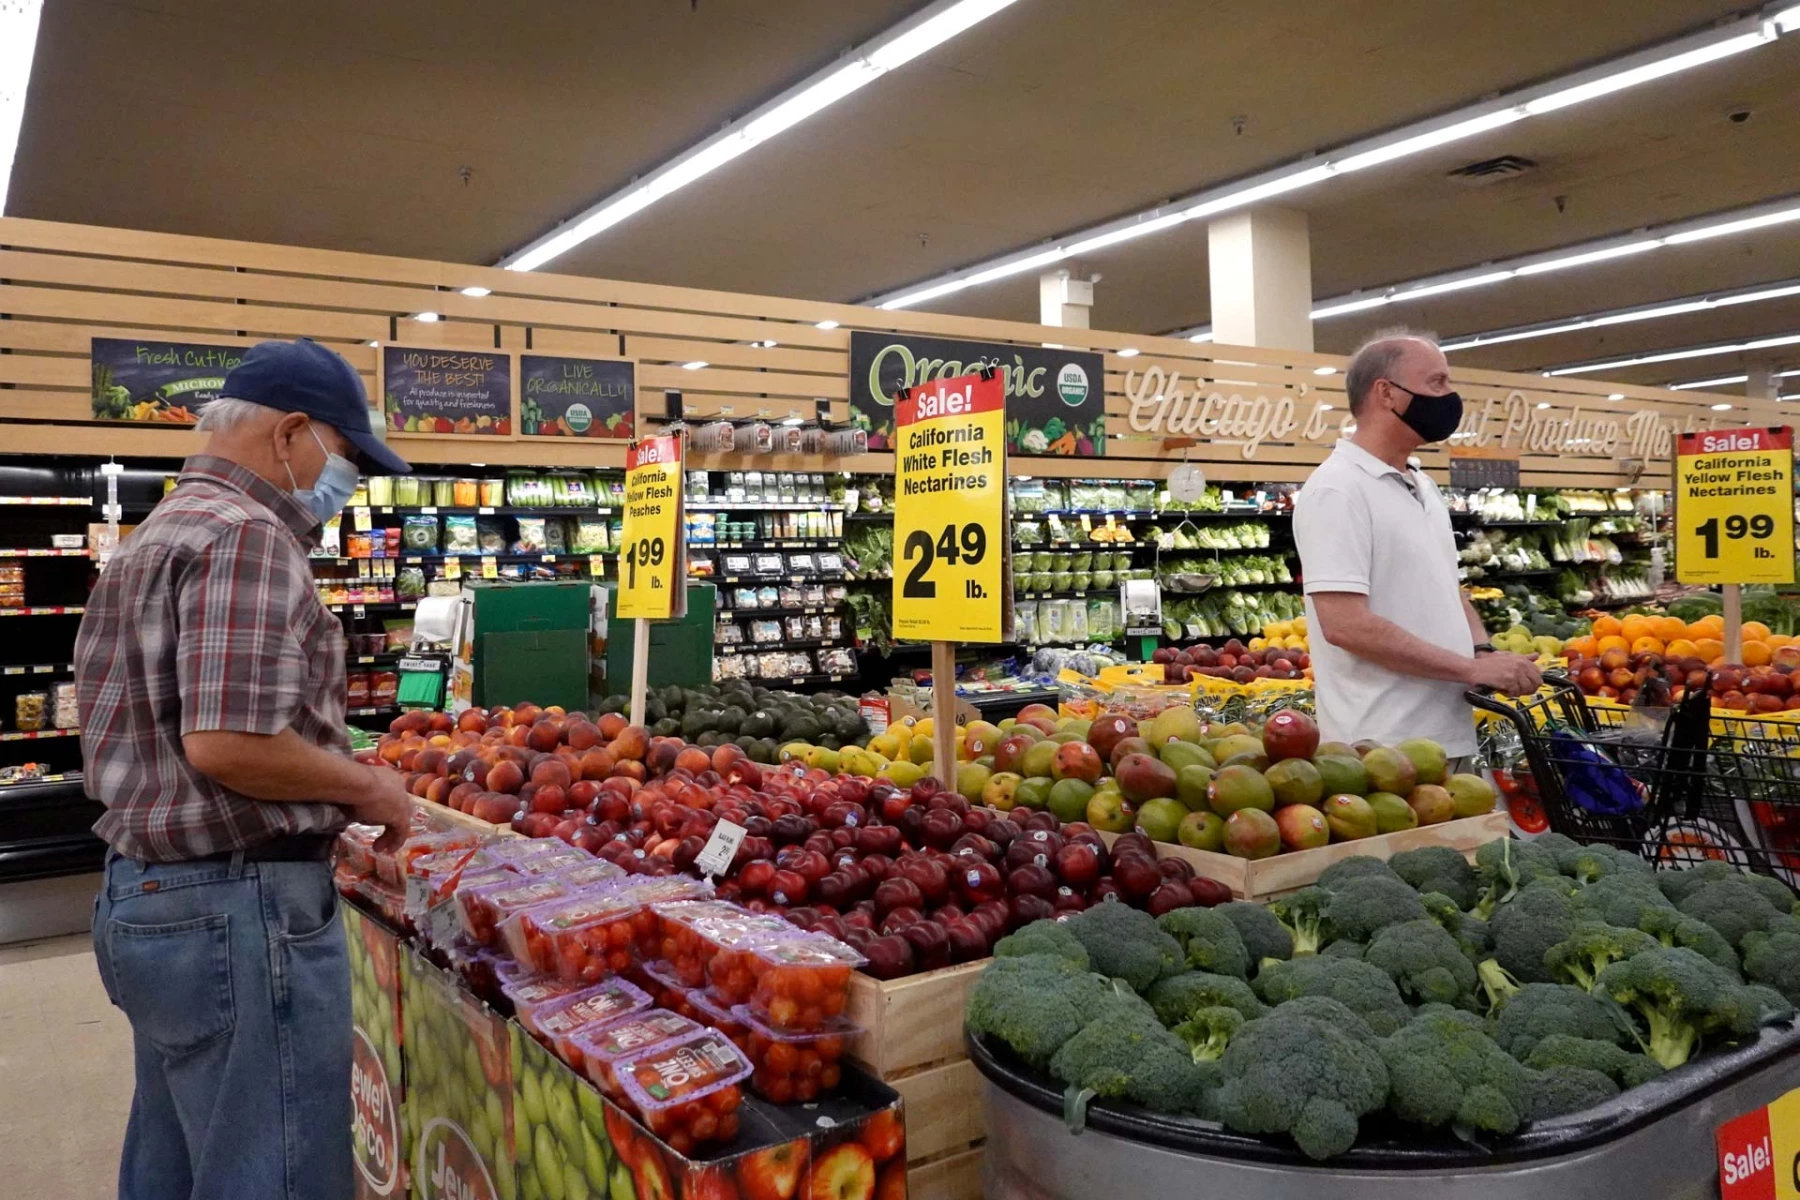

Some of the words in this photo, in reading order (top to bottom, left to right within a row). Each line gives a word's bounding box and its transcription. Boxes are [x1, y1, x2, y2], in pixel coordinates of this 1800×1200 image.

[136, 346, 181, 366] Fresh
[185, 350, 212, 368] Cut
[403, 353, 428, 368] YOU
[431, 355, 494, 371] DESERVE
[414, 370, 440, 386] THE
[445, 373, 485, 387] BEST!
[563, 364, 593, 379] LIVE
[1064, 373, 1082, 383] USDA
[527, 378, 627, 400] ORGANICALLY
[917, 384, 972, 419] Sale!
[1124, 365, 1328, 460] Chicago's
[1501, 389, 1619, 454] Produce
[910, 424, 984, 450] California
[1703, 433, 1760, 453] Sale!
[903, 453, 936, 473] White
[942, 446, 992, 468] Flesh
[1694, 456, 1771, 470] California
[631, 470, 667, 487] California
[904, 473, 987, 495] Nectarines
[1684, 473, 1731, 484] Yellow
[1736, 470, 1783, 482] Flesh
[646, 485, 673, 499] Flesh
[1689, 485, 1776, 497] Nectarines
[630, 504, 661, 518] Peaches
[1754, 547, 1775, 559] lb.
[651, 576, 663, 589] lb.
[966, 580, 987, 598] lb.
[653, 1058, 690, 1086] ONE
[675, 1048, 707, 1078] SWEET
[351, 1061, 384, 1125] ewel
[1724, 1135, 1771, 1185] Sale!
